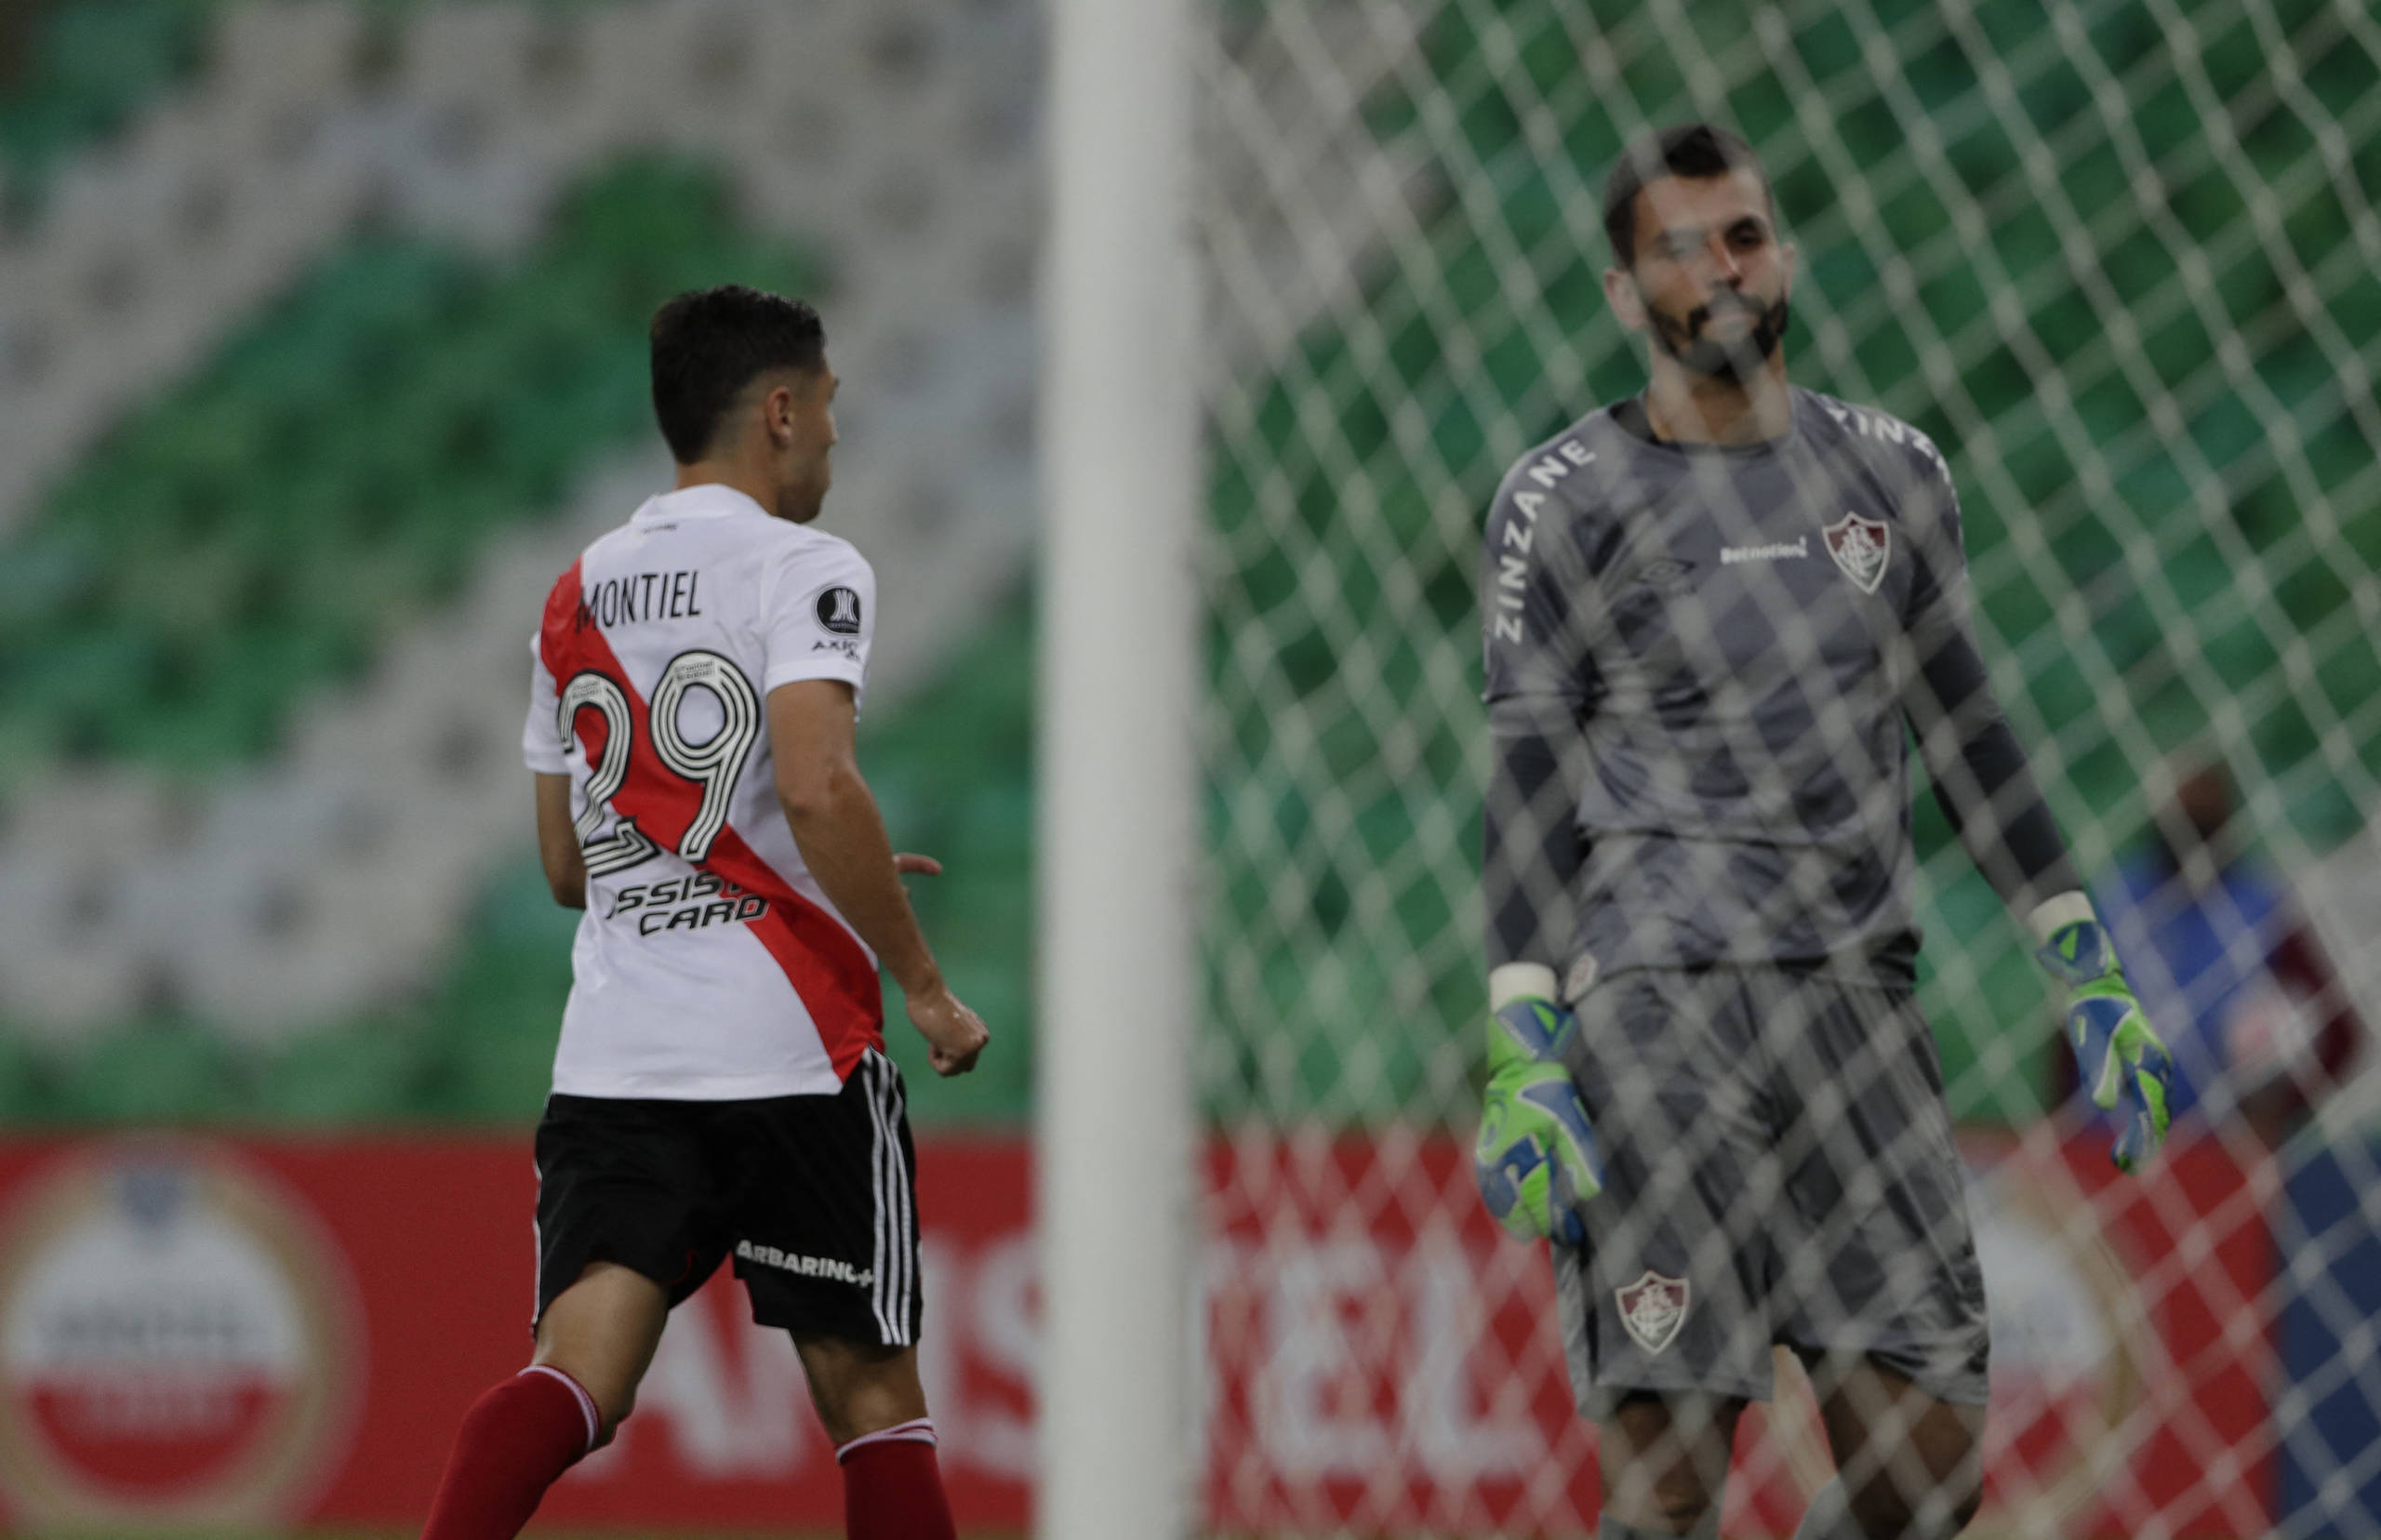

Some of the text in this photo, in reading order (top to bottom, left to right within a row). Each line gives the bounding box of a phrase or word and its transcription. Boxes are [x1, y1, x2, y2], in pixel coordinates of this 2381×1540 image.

[1495, 439, 1596, 644] ZINZANE
[575, 570, 702, 633] MONTIEL
[558, 650, 760, 879] 29
[606, 870, 741, 919] SSIS
[640, 894, 769, 936] CARD
